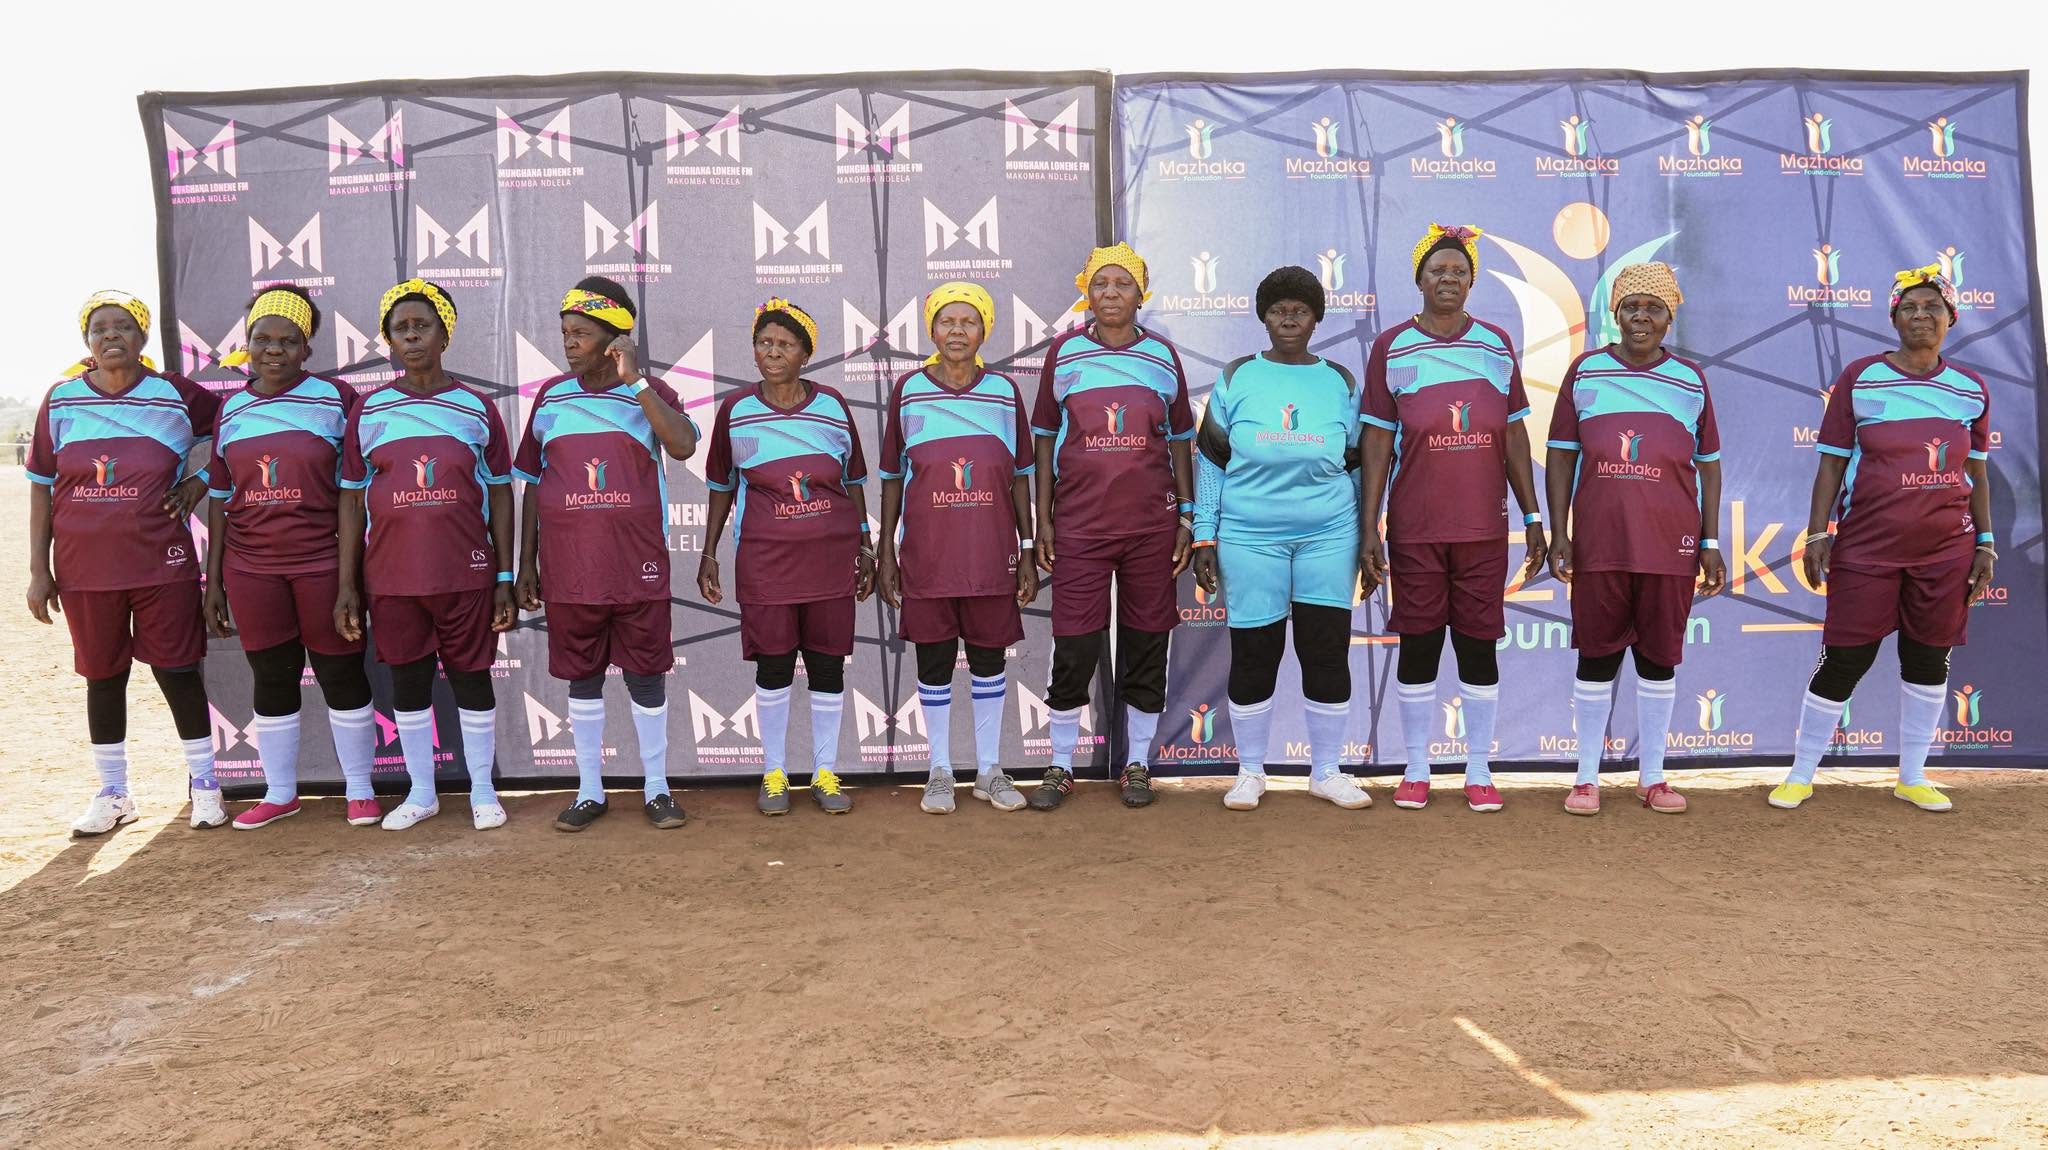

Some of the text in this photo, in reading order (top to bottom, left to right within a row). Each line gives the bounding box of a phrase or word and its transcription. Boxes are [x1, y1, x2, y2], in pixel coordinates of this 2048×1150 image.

[1006, 161, 1050, 171] MUNGHANA
[1079, 162, 1090, 171] FM
[1286, 157, 1370, 173] Mazhaka
[1411, 157, 1496, 173] Mazhaka
[1536, 156, 1619, 171] Mazhaka
[1659, 154, 1742, 171] Mazhaka
[1780, 153, 1863, 170] Mazhaka
[1904, 155, 1986, 173] Mazhaka
[498, 168, 542, 178] MUNGHANA
[572, 167, 584, 176] FM
[667, 166, 711, 176] MUNGHANA
[741, 166, 753, 176] FM
[837, 164, 881, 175] MUNGHANA
[911, 163, 923, 172] FM
[1159, 159, 1245, 176] Mazhaka
[1804, 169, 1841, 177] Foundation
[329, 174, 374, 185] MUNGHANA
[405, 170, 416, 180] FM
[667, 177, 741, 185] MAKOMBA NDLELA
[837, 175, 911, 184] MAKOMBA NDLELA
[1006, 172, 1078, 181] MAKOMBA NDLELA
[1184, 174, 1222, 182] Foundation
[171, 183, 209, 195] MUNGHANA
[238, 182, 249, 191] FM
[498, 178, 571, 188] MAKOMBA NDLELA
[329, 183, 404, 195] MAKOMBA NDLELA
[171, 194, 237, 205] MAKOMBA NDLELA
[585, 264, 630, 274] MUNGHANA
[660, 264, 672, 273] FM
[756, 265, 801, 275] MUNGHANA
[831, 264, 842, 273] FM
[927, 260, 972, 270] MUNGHANA
[1001, 259, 1012, 269] FM
[417, 268, 461, 278] MUNGHANA
[491, 268, 502, 277] FM
[927, 271, 1000, 280] MAKOMBA NDLELA
[324, 277, 335, 286] FM
[460, 279, 489, 287] NDLELA
[629, 275, 659, 283] NDLELA
[756, 276, 830, 285] MAKOMBA NDLELA
[1788, 285, 1871, 302] Mazhaka
[1163, 293, 1249, 311] Mazhaka
[1187, 309, 1226, 317] Foundation
[1014, 357, 1045, 368] MUNGH
[845, 373, 885, 382] MAKOMBA
[1086, 434, 1146, 447] Mazhaka
[1257, 431, 1324, 443] Mazhaka
[1429, 432, 1492, 447] Mazhaka
[1598, 461, 1661, 478] Mazhaka
[72, 485, 138, 498] Mazhaka
[245, 487, 301, 502] Mazhaka
[393, 488, 457, 504] Mazhaka
[932, 490, 993, 504] Mazhaka
[565, 491, 631, 506] Mazhaka
[775, 499, 831, 515] Mazhaka
[1187, 620, 1225, 628] Foundation
[510, 660, 521, 668] FM
[1094, 736, 1105, 744] FM
[1667, 731, 1753, 748] Mazhaka
[605, 747, 617, 756] FM
[697, 747, 764, 755] MUNGHANA LONEN
[904, 744, 929, 752] LONEN
